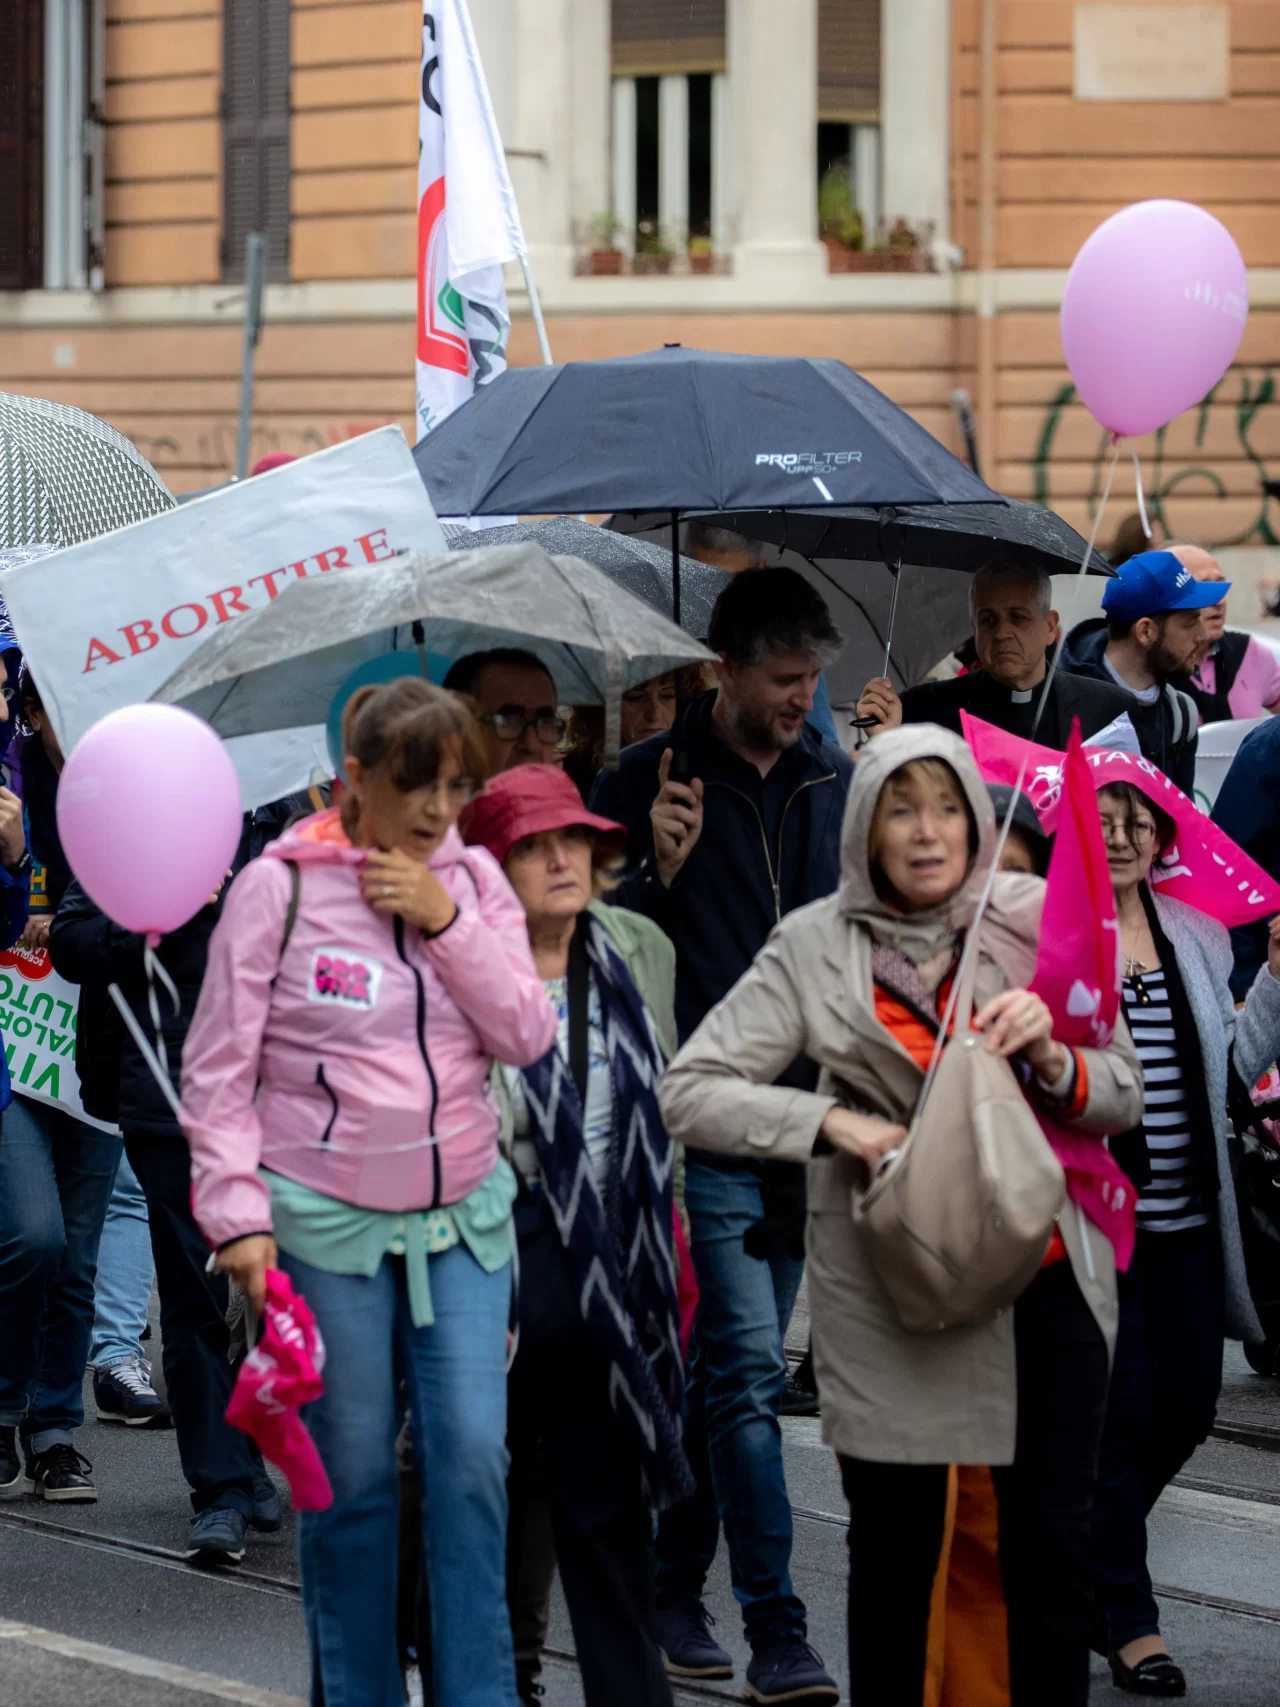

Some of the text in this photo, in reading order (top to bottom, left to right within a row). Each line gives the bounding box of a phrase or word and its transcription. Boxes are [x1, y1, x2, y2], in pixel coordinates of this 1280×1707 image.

[755, 451, 862, 469] PROFILTER
[81, 528, 399, 674] ABORTIRE
[1086, 750, 1132, 767] TA
[4, 1043, 60, 1099] VIT
